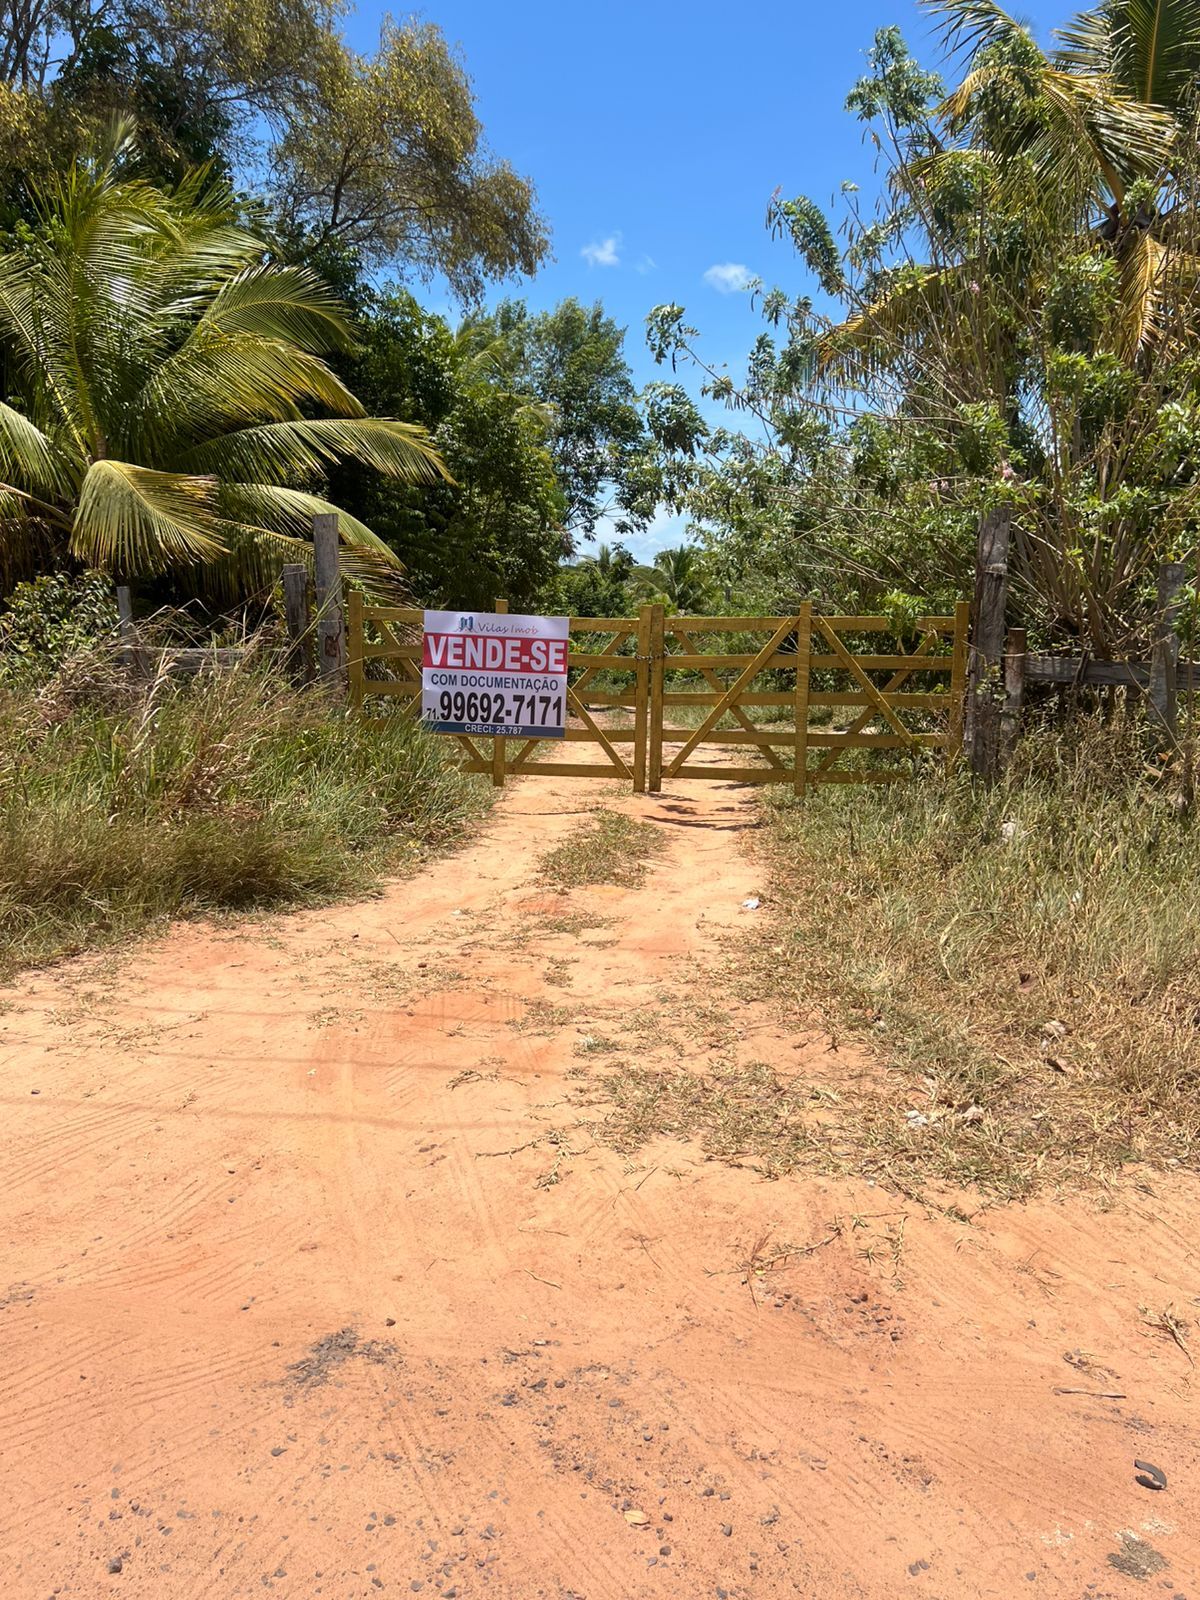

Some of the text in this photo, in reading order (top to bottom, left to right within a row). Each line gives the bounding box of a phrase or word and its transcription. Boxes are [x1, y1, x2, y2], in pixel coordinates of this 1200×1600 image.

[478, 622, 539, 635] Vilas Imob
[427, 635, 565, 672] VENDE-SE
[431, 673, 559, 693] COM DOCUMENTAÇÃO
[465, 724, 523, 735] CRECI: 25.787
